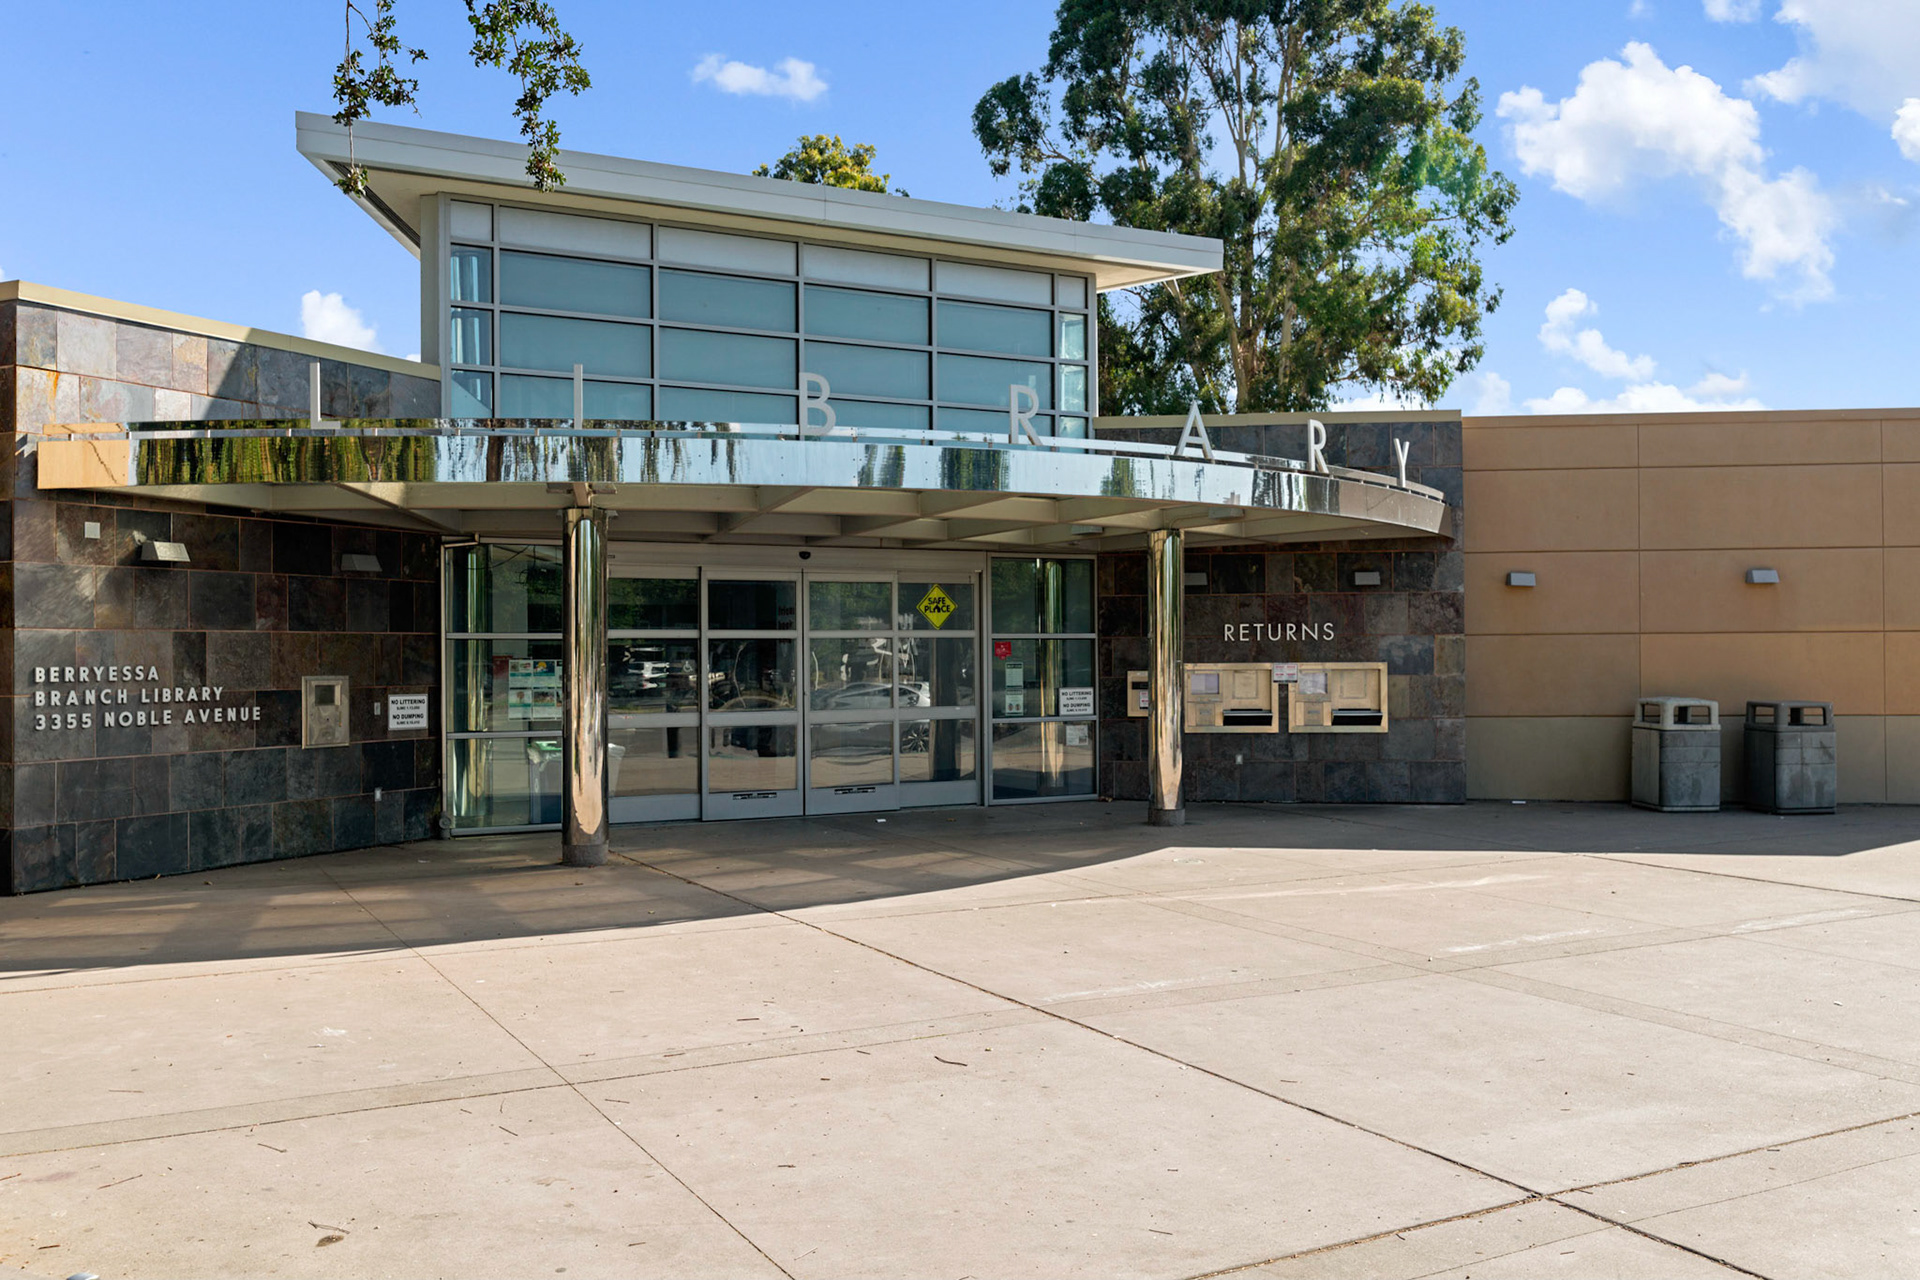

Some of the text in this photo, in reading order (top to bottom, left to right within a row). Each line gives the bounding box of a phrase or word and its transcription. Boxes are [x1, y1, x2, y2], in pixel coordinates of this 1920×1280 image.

[309, 362, 1410, 487] LIBRARY
[924, 604, 951, 613] PLACE
[928, 597, 946, 605] SAFE
[1224, 622, 1335, 642] RETURNS
[35, 665, 159, 682] BERRYESSA
[35, 686, 223, 706] BRANCH LIBRARY
[35, 706, 261, 730] 3355 NOBLE AVENUE
